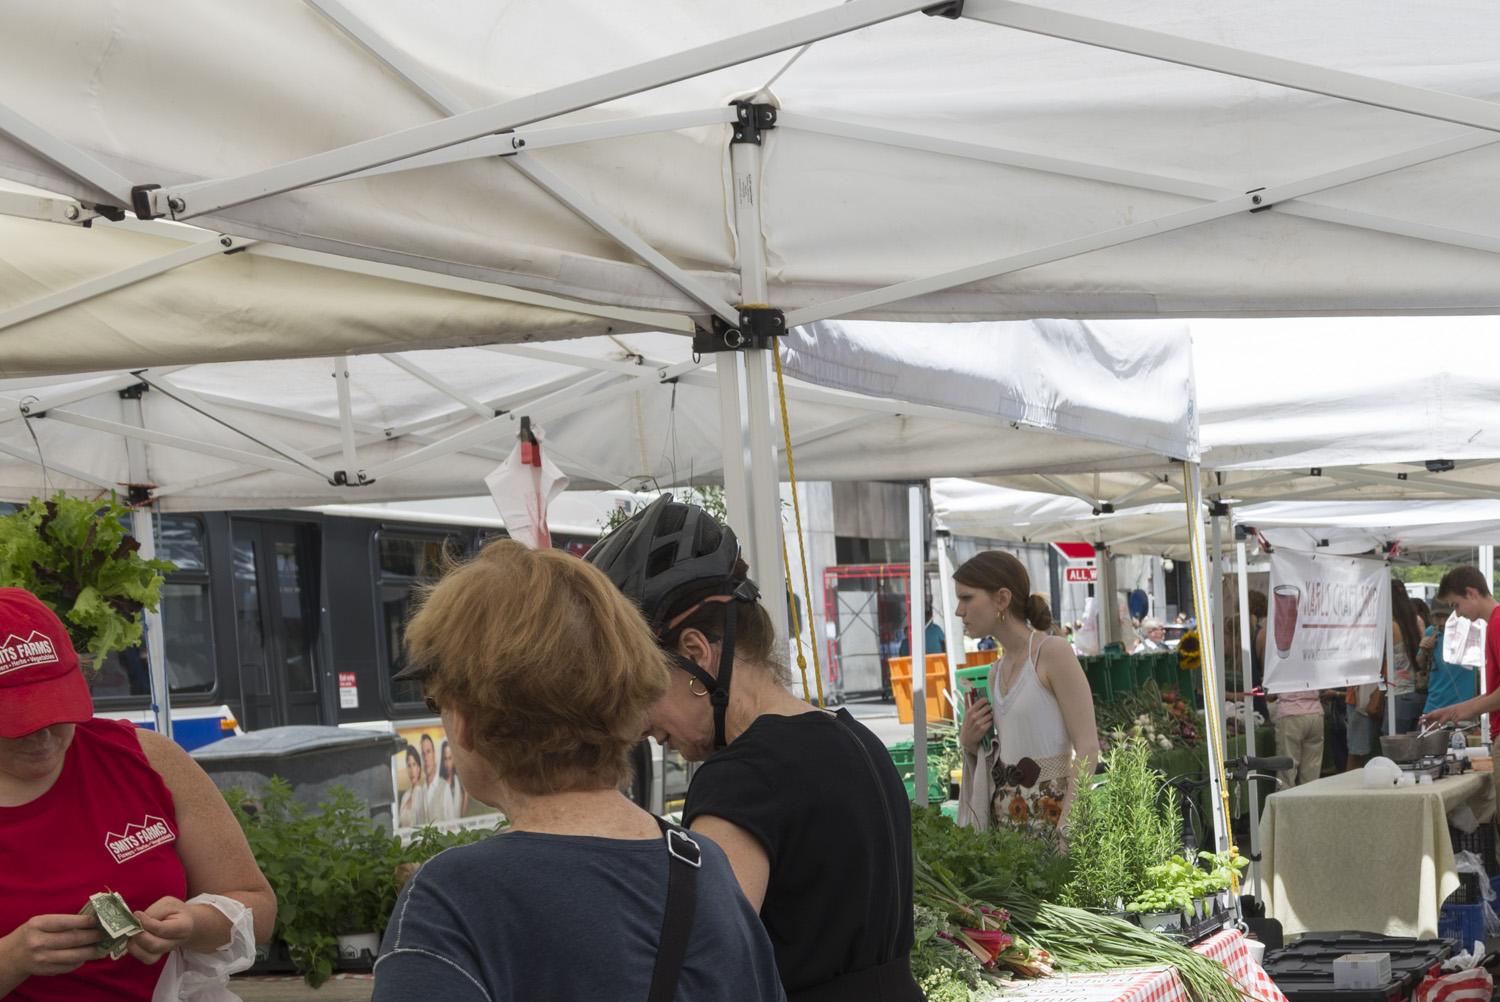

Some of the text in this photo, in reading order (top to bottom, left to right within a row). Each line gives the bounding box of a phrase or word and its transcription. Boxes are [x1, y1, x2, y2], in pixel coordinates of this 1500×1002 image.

[1070, 569, 1088, 580] ALL
[0, 640, 52, 665] ITS FARMS
[109, 822, 167, 854] SMITS FARMS
